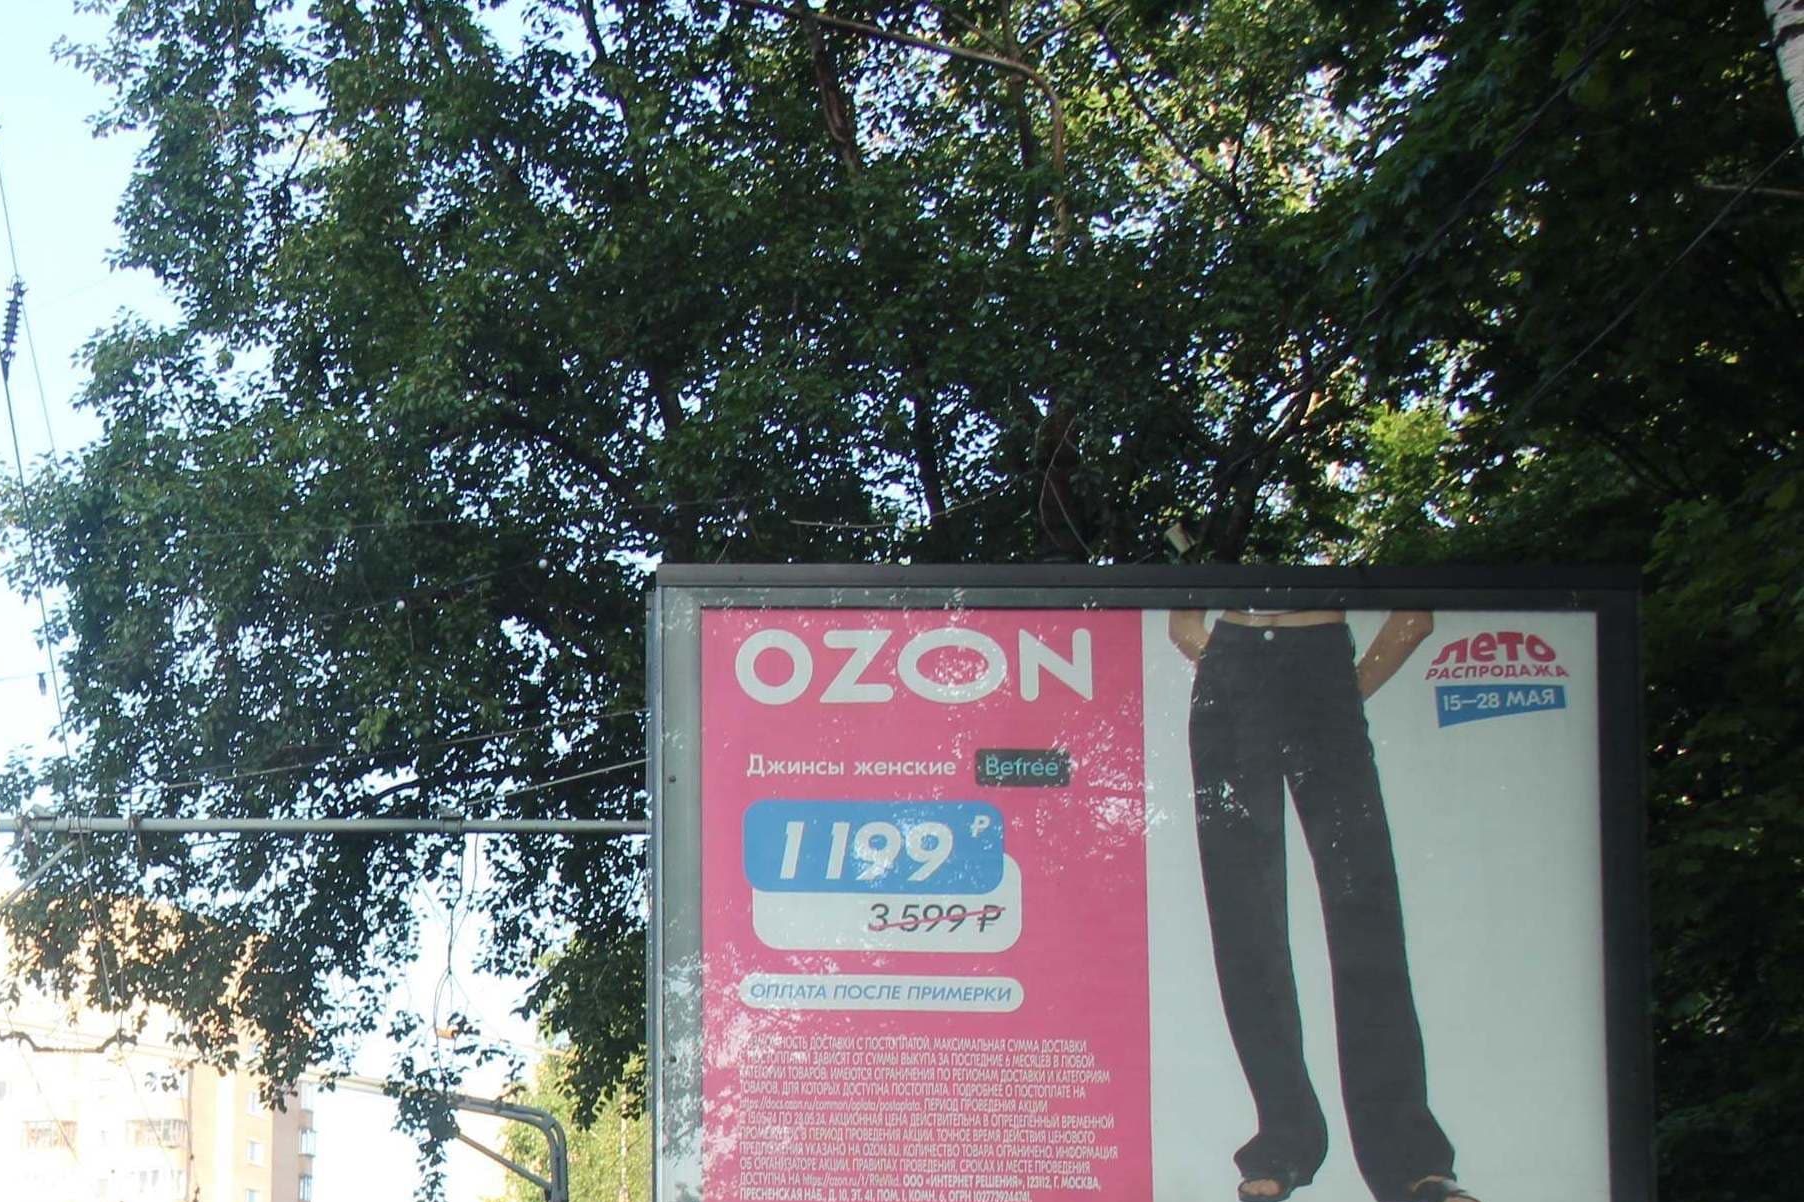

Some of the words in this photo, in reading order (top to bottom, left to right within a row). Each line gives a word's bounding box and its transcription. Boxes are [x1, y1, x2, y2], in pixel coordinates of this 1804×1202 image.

[735, 628, 1093, 705] OZON
[1425, 664, 1570, 680] РАСПРОДАЖА
[1506, 689, 1555, 707] МАЯ
[746, 754, 845, 777] Джинсы
[853, 756, 956, 776] женские
[985, 754, 1059, 777] Befree
[750, 983, 828, 999] ОПЛАТА
[833, 984, 901, 1000] ПОСЛЕ
[907, 986, 1012, 1002] ПРИМЕРКИ
[1007, 1039, 1039, 1052] СУММА
[1042, 1039, 1087, 1054] ДОСТАВКИ
